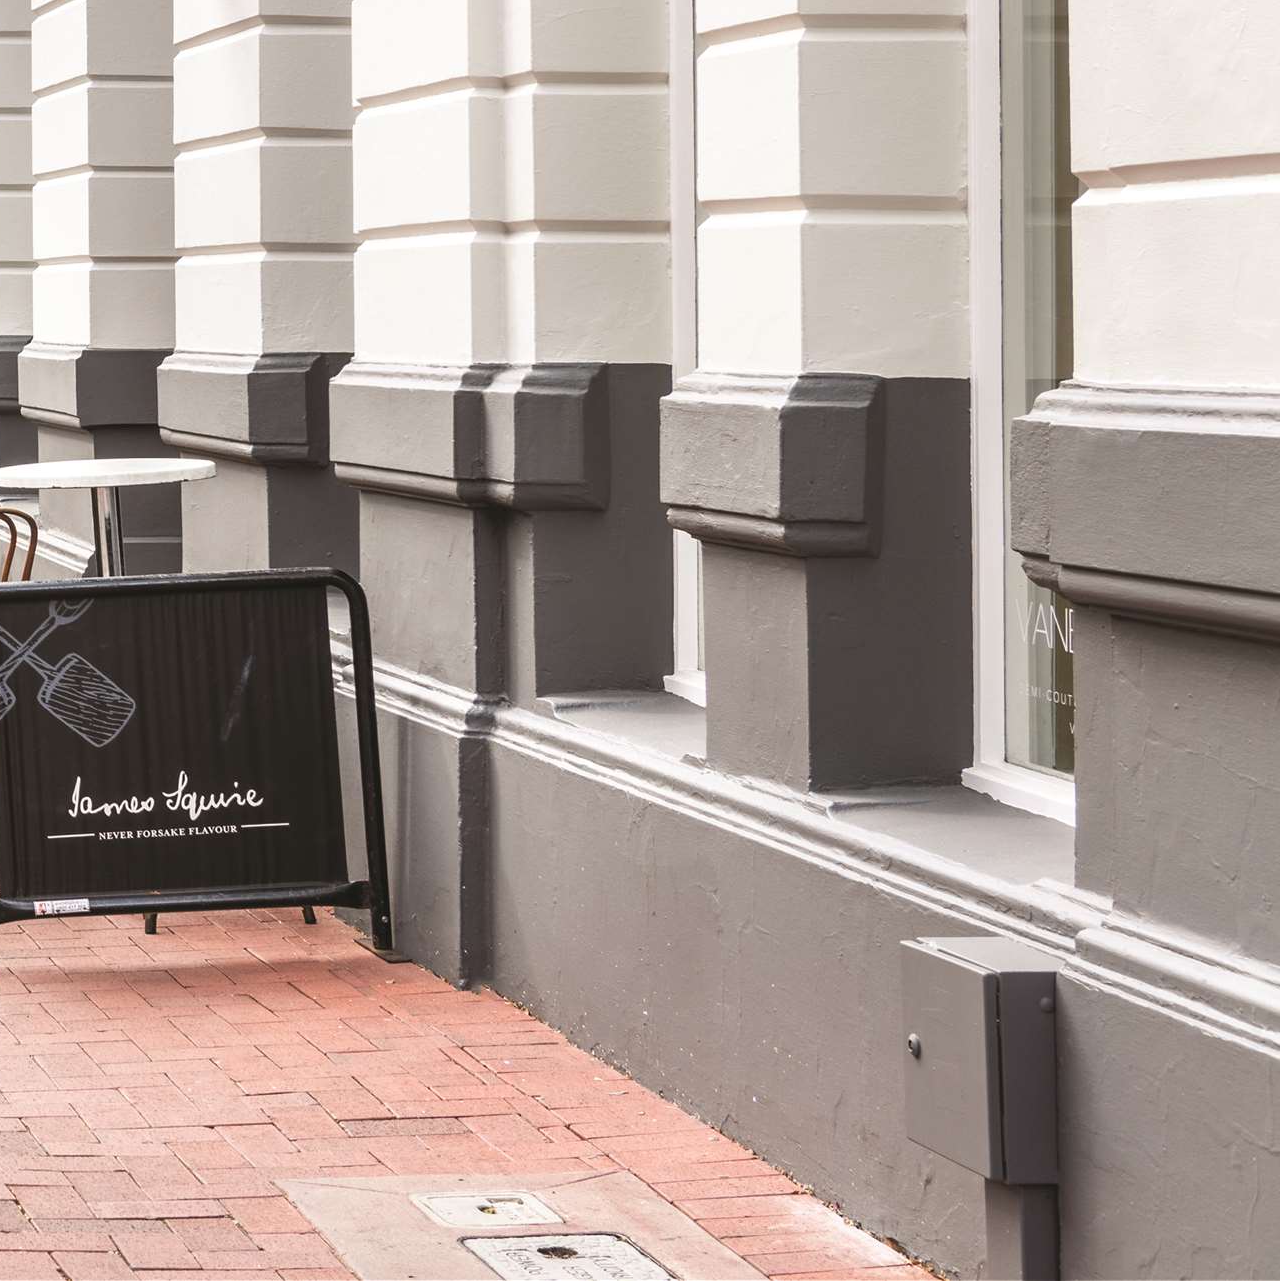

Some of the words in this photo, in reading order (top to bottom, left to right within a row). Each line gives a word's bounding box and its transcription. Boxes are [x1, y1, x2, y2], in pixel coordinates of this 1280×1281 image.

[98, 830, 134, 840] NEVER
[136, 828, 185, 839] FORSAKE
[188, 824, 238, 836] FLAVOUR
